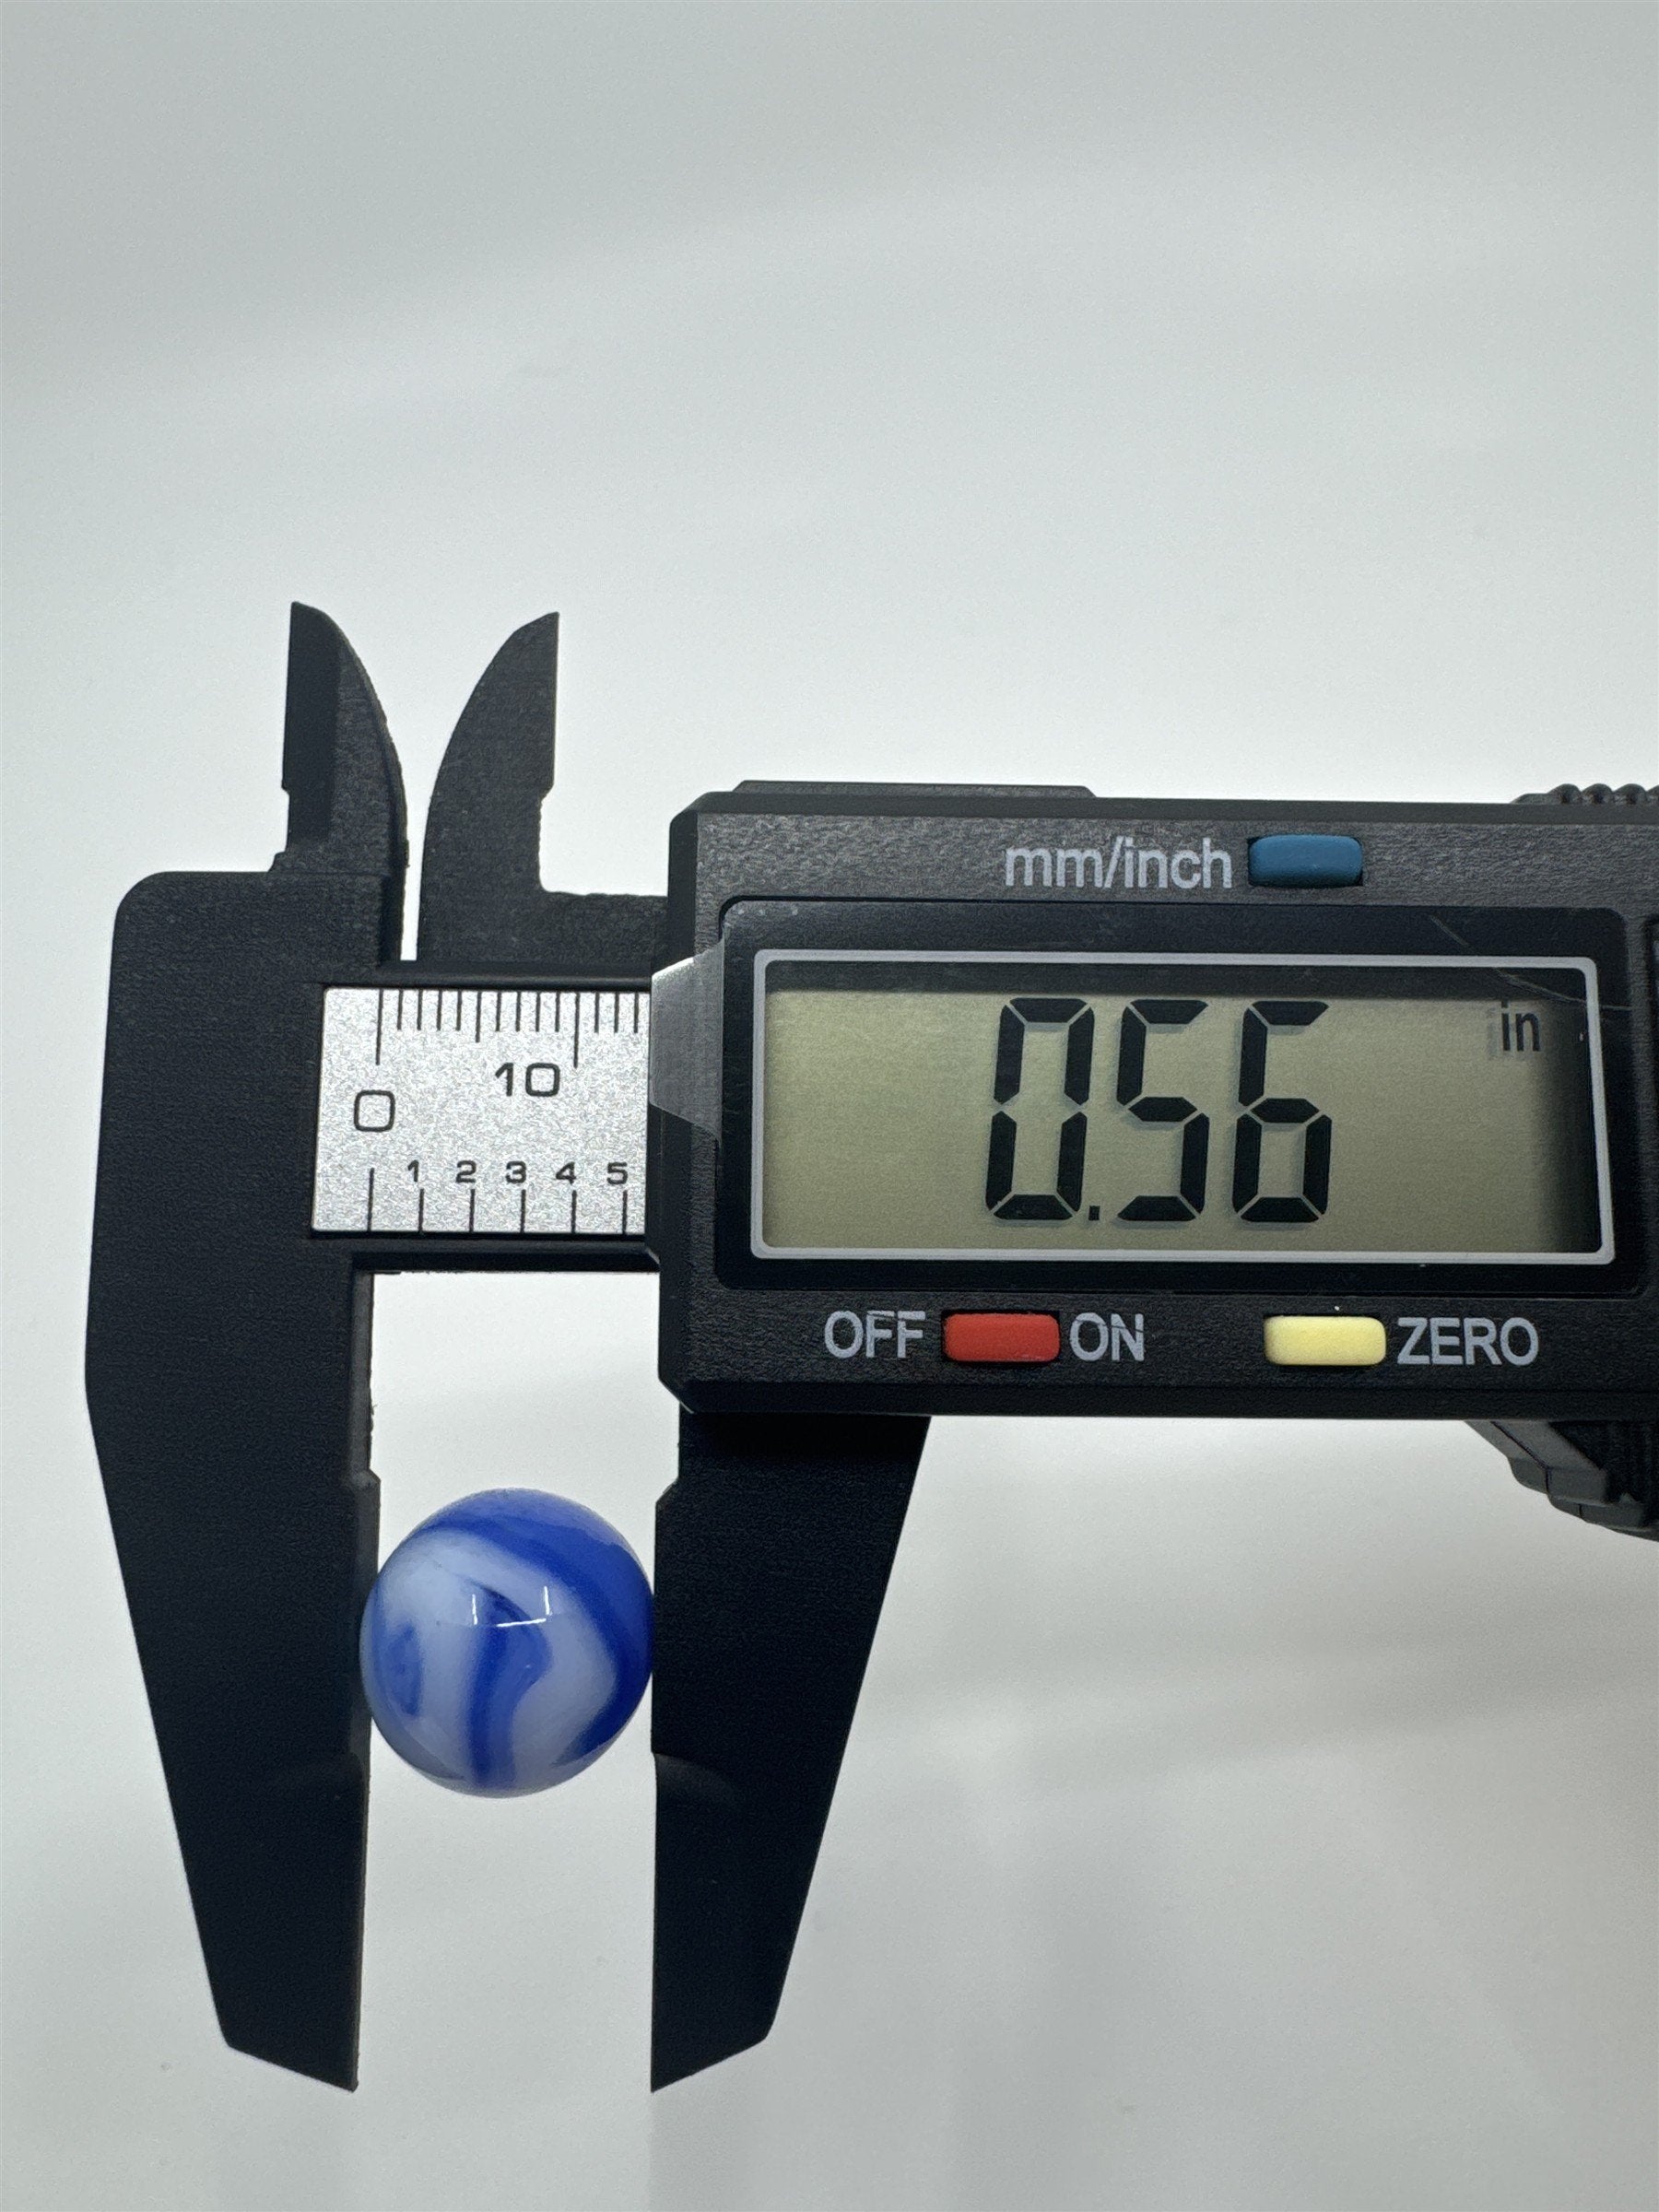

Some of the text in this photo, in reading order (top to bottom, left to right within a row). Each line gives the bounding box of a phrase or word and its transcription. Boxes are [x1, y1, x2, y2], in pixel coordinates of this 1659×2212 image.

[1004, 835, 1233, 890] mm/inch
[1500, 1001, 1541, 1053] in
[493, 1062, 561, 1097] 10
[353, 1089, 396, 1133] 0
[985, 997, 1333, 1222] 0.56
[406, 1159, 629, 1186] 1 2 3 4 5
[823, 1310, 926, 1359] OFF
[1068, 1312, 1146, 1363] ON
[1395, 1316, 1540, 1367] ZERO
